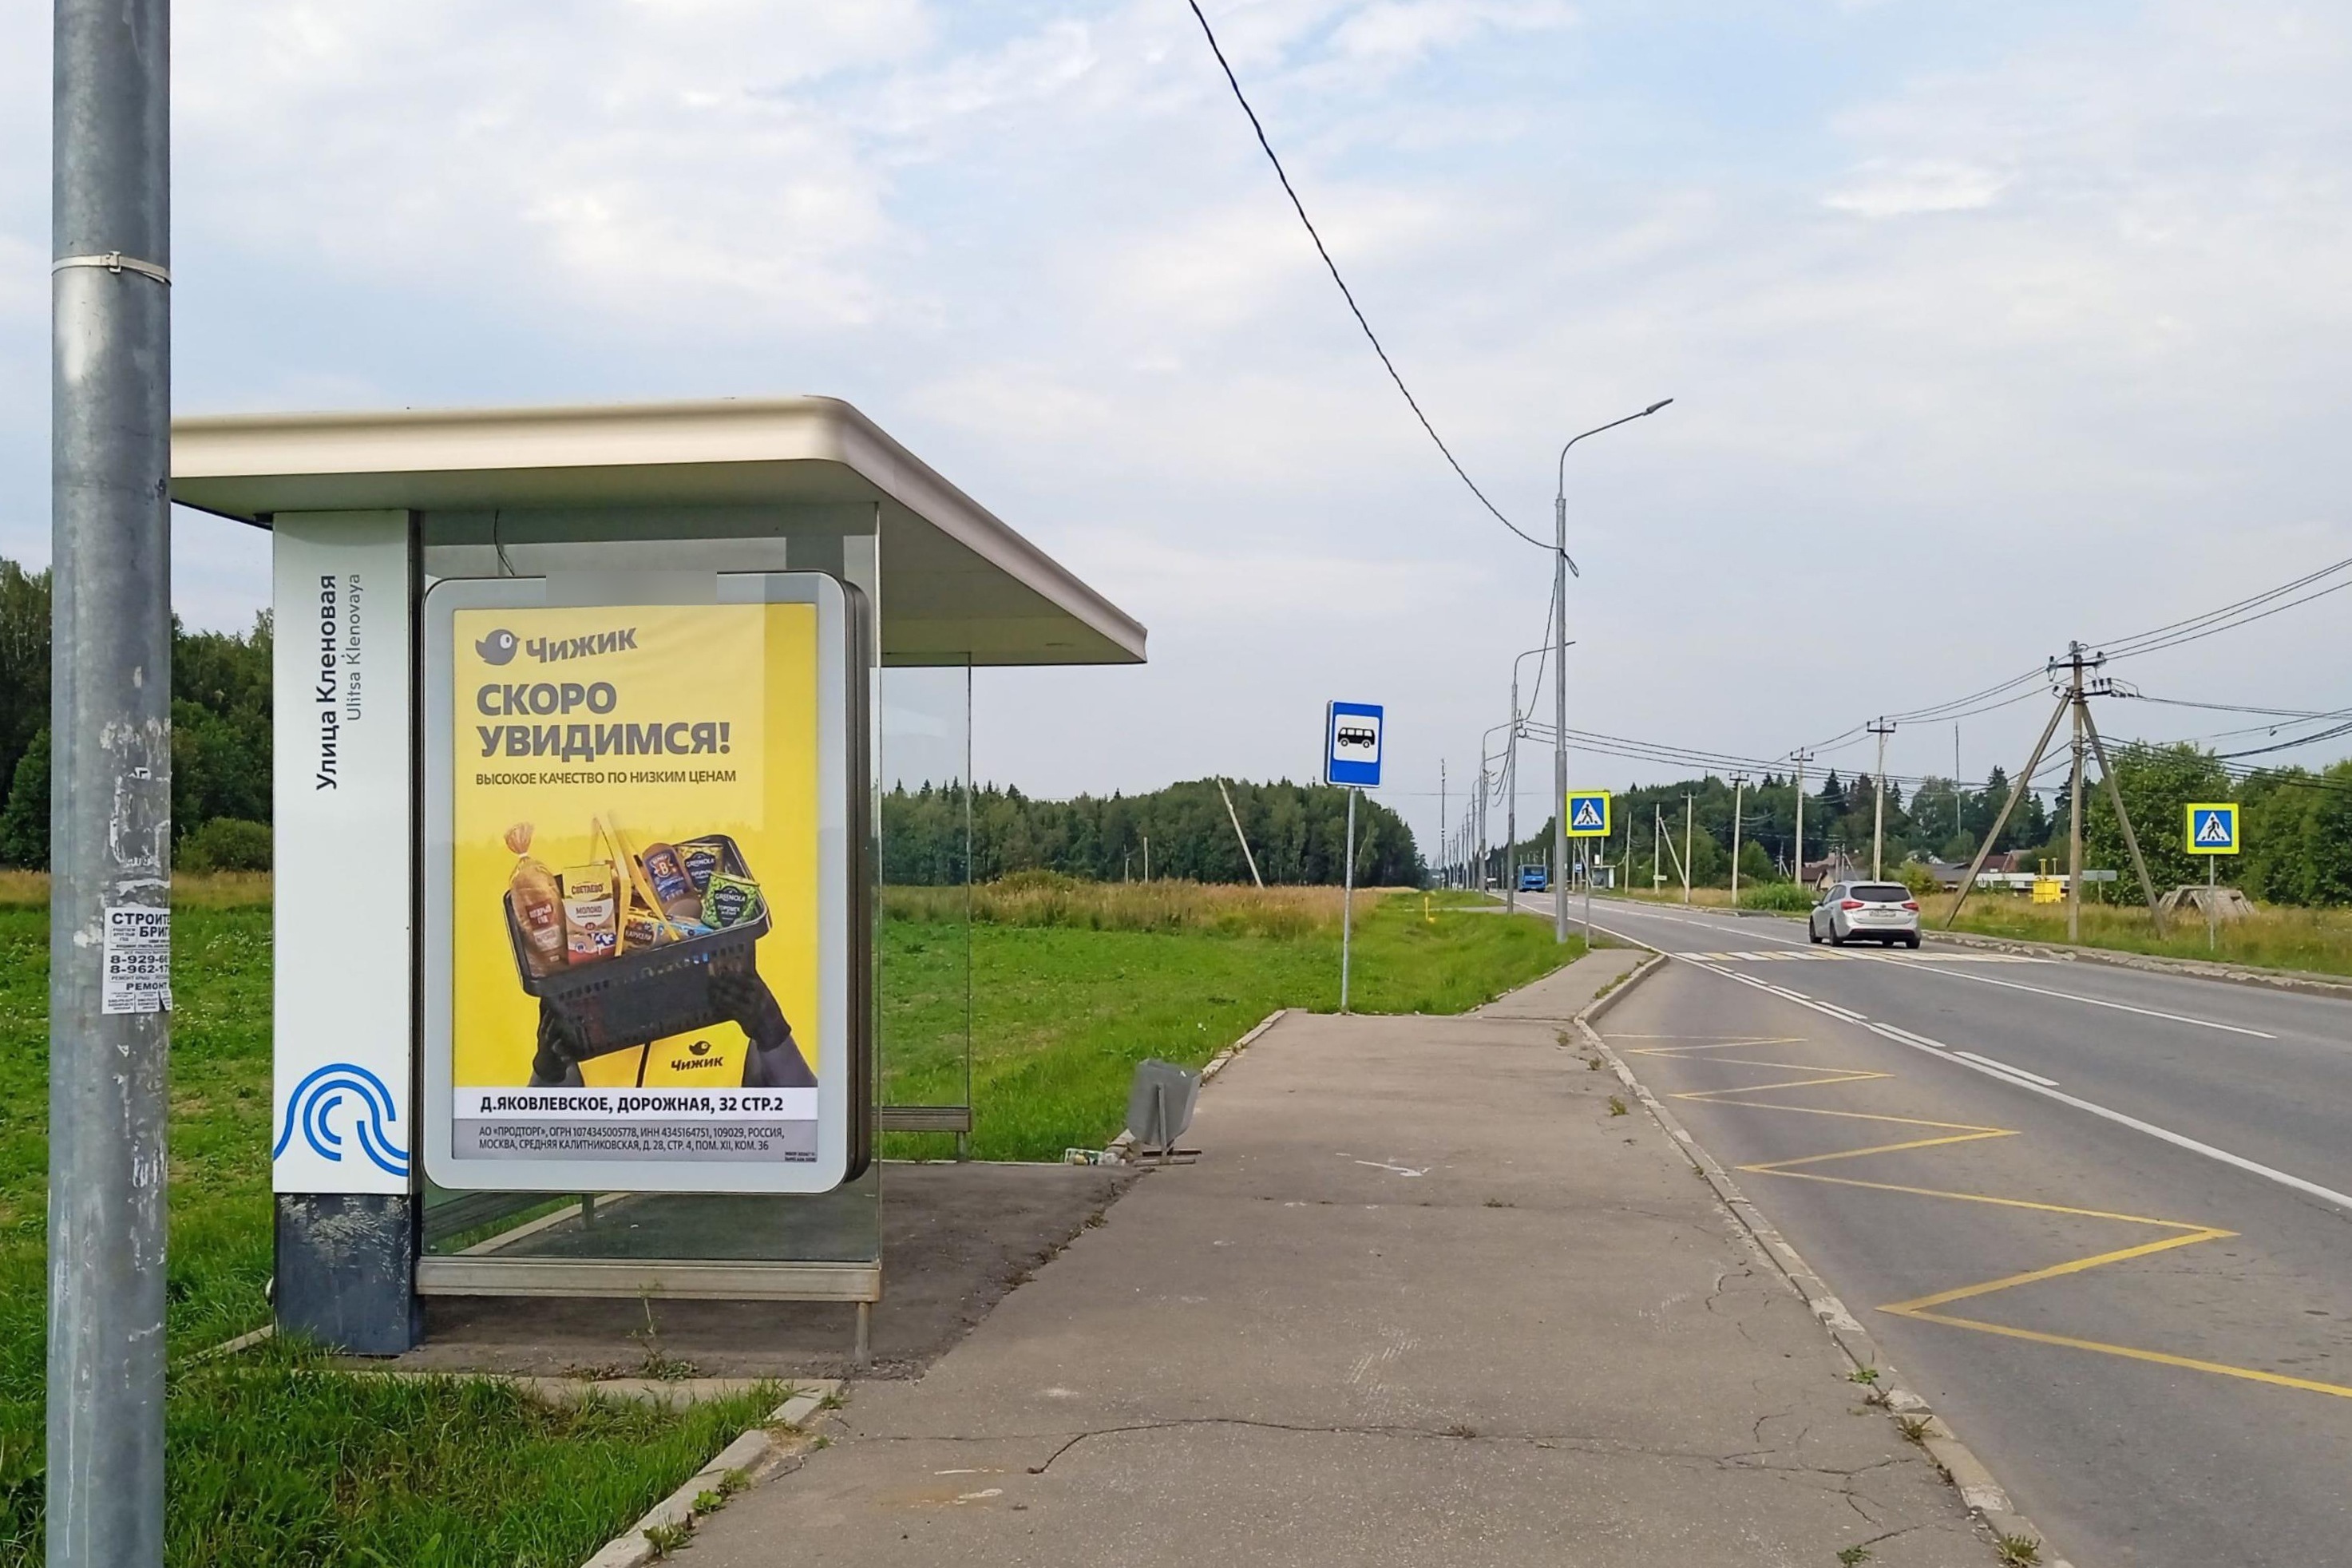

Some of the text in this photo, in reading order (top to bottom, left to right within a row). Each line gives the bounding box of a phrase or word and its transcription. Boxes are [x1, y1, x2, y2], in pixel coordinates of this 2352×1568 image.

[345, 573, 364, 722] Ulitsa Klenovaya
[315, 575, 340, 790] Улица Кленовая
[476, 681, 618, 716] СКОРО
[476, 721, 731, 763] УВИДИМСЯ!
[475, 770, 737, 786] ВЫСОКОЕ КАЧЕСТВО ПО НИЗКИМ ЦЕНАМ
[686, 857, 715, 868] GREENOLA
[715, 892, 746, 902] GREENOLA
[139, 926, 169, 937] БРИГ
[125, 982, 168, 991] РЕМОНТ
[480, 1096, 784, 1115] Д.ЯКОВЛЕВСКОЕ, ДОРОЖНАЯ, 32 СТР.2
[479, 1127, 785, 1139] АО «ПРОДТОРГ», ОГРН 1074345005778, ИНН 4345164751, 109029, РОССИЯ,
[479, 1139, 518, 1150] МОСКВА,
[519, 1139, 558, 1150] СРЕДНЯЯ
[559, 1139, 641, 1151] КАЛИТНИКОВСКАЯ,
[642, 1140, 652, 1151] Д.
[653, 1140, 667, 1151] 28,
[667, 1140, 685, 1150] СТР.
[686, 1140, 695, 1151] 4,
[695, 1140, 719, 1150] ПОМ.
[735, 1140, 757, 1150] КОМ.
[758, 1140, 769, 1150] 36
